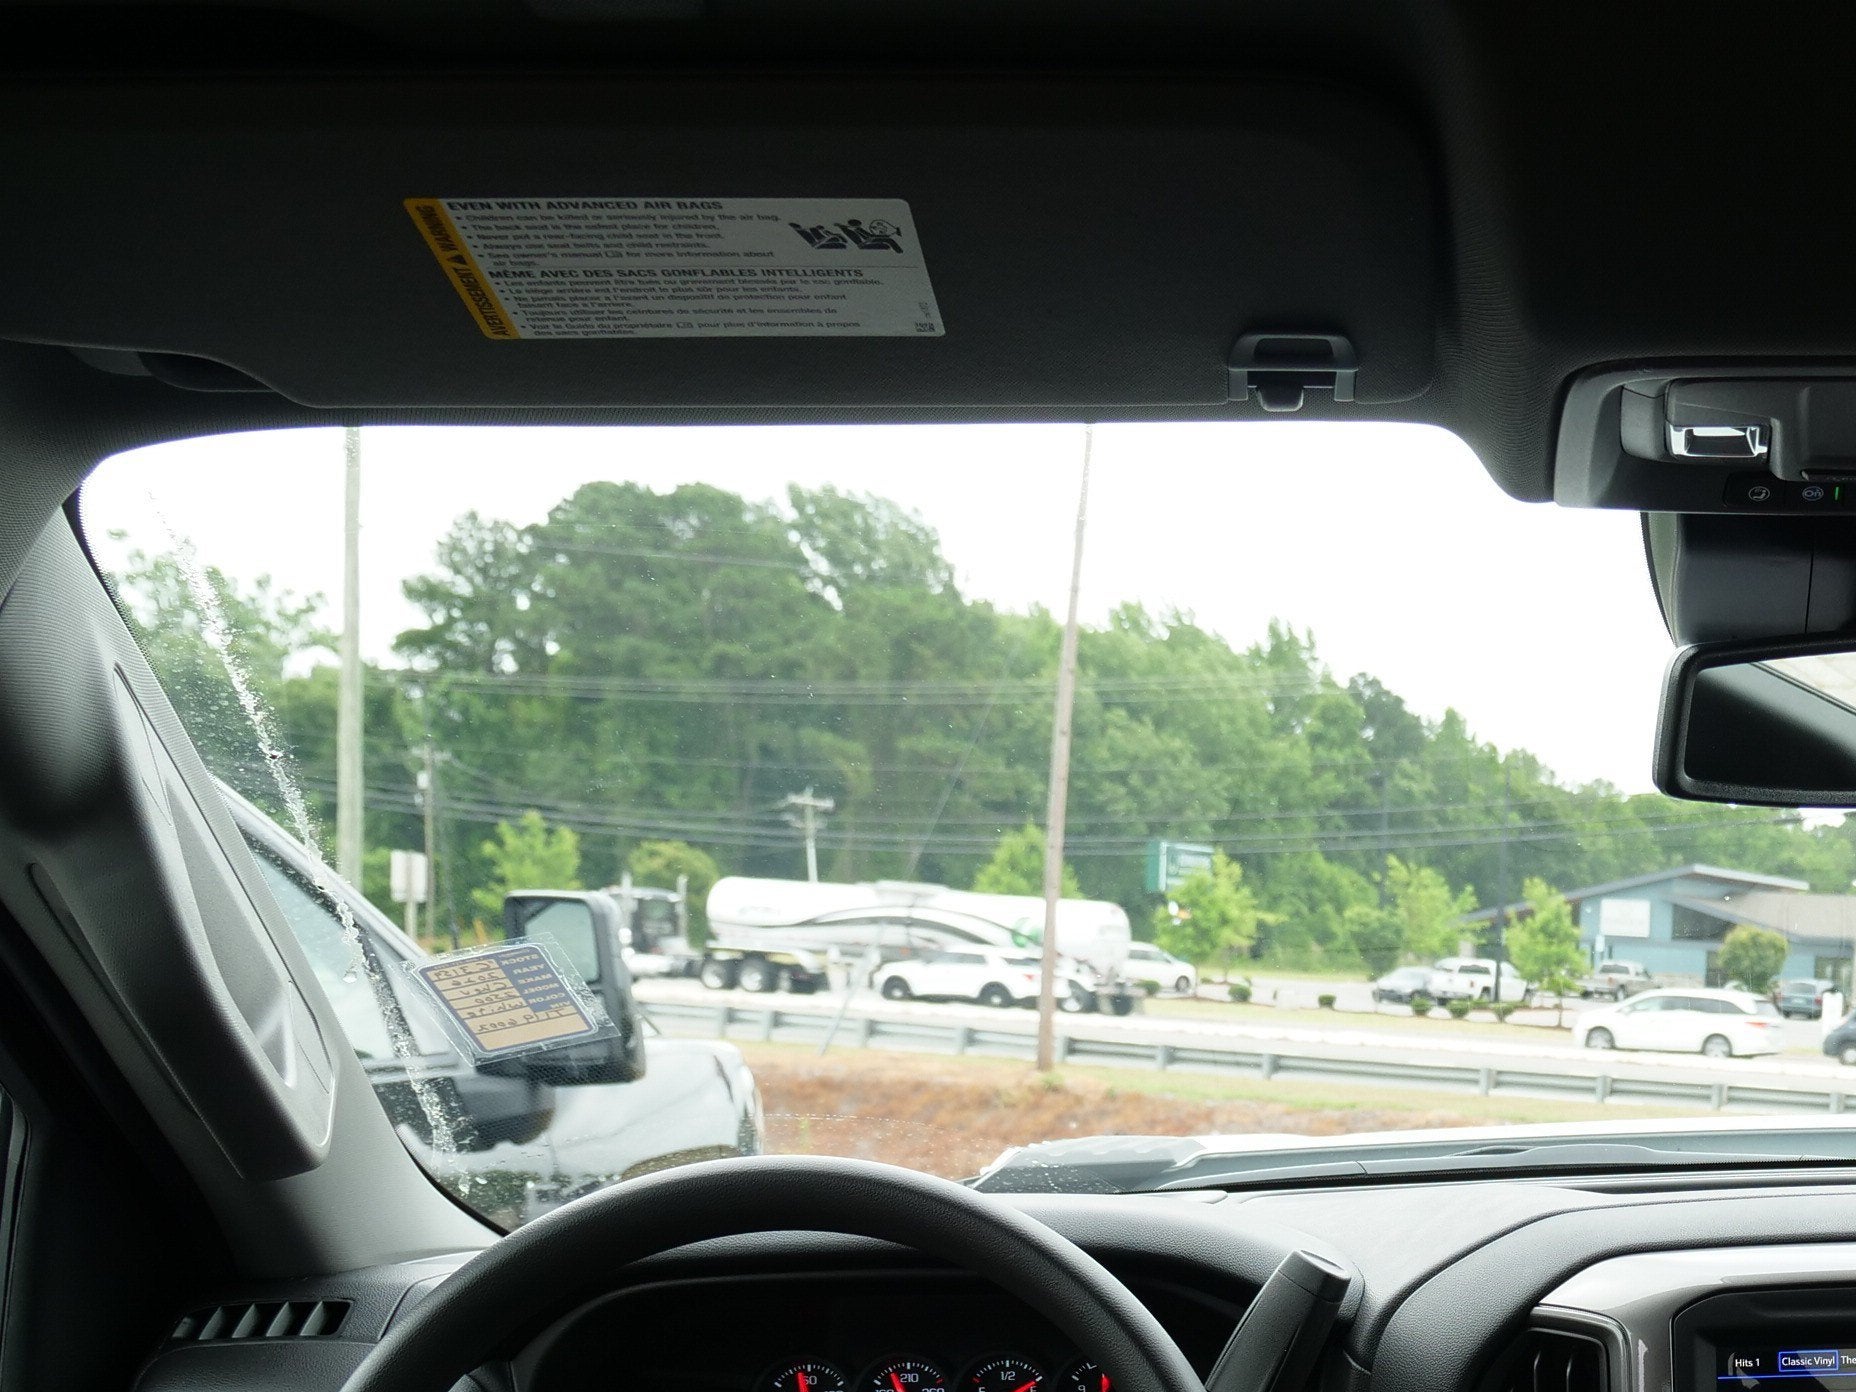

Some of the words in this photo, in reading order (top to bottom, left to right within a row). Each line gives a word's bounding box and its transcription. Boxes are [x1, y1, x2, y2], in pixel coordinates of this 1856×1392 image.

[447, 201, 491, 211] EVEN
[497, 201, 540, 210] WITH
[546, 201, 637, 210] ADVANCED
[644, 201, 672, 210] AIR
[677, 201, 723, 210] BAGS
[415, 203, 456, 251] WARNING
[540, 269, 579, 278] AVEC
[584, 269, 613, 278] DES
[617, 269, 658, 278] SACS
[661, 269, 758, 278] GONFLABLES
[761, 269, 864, 278] INTELLIGENTS
[453, 267, 510, 336] AVERTISSEMENT
[1735, 1358, 1753, 1368] Hits
[1755, 1358, 1760, 1368] 1
[1781, 1356, 1811, 1366] Classic
[1812, 1355, 1836, 1366] Vinyl
[1841, 1355, 1856, 1365] The
[900, 1373, 919, 1383] 210
